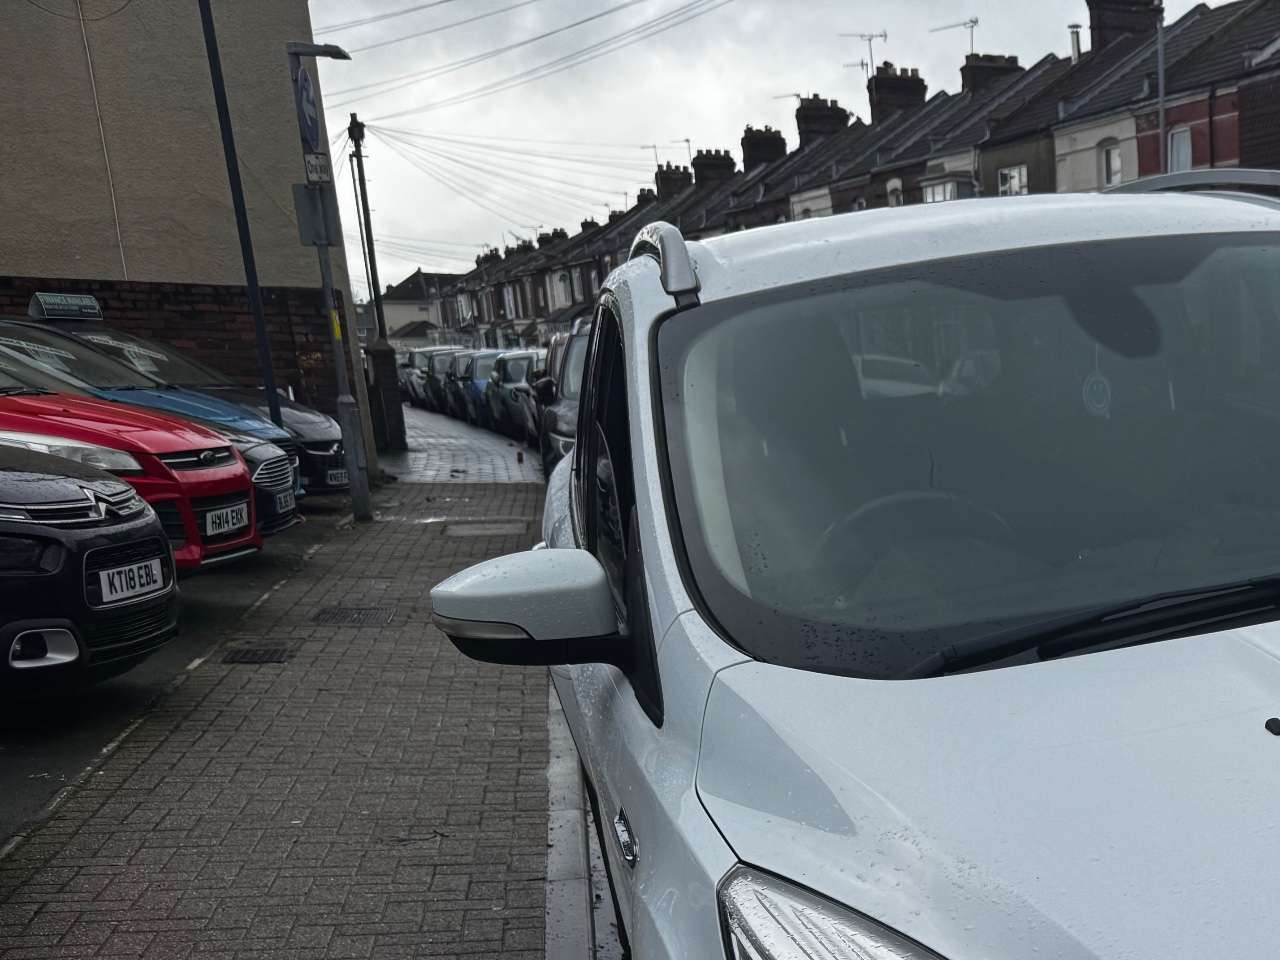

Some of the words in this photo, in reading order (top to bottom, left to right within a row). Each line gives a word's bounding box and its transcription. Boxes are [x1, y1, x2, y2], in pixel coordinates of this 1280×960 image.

[308, 159, 319, 175] One
[107, 568, 137, 596] KT18
[136, 562, 158, 588] EBL
